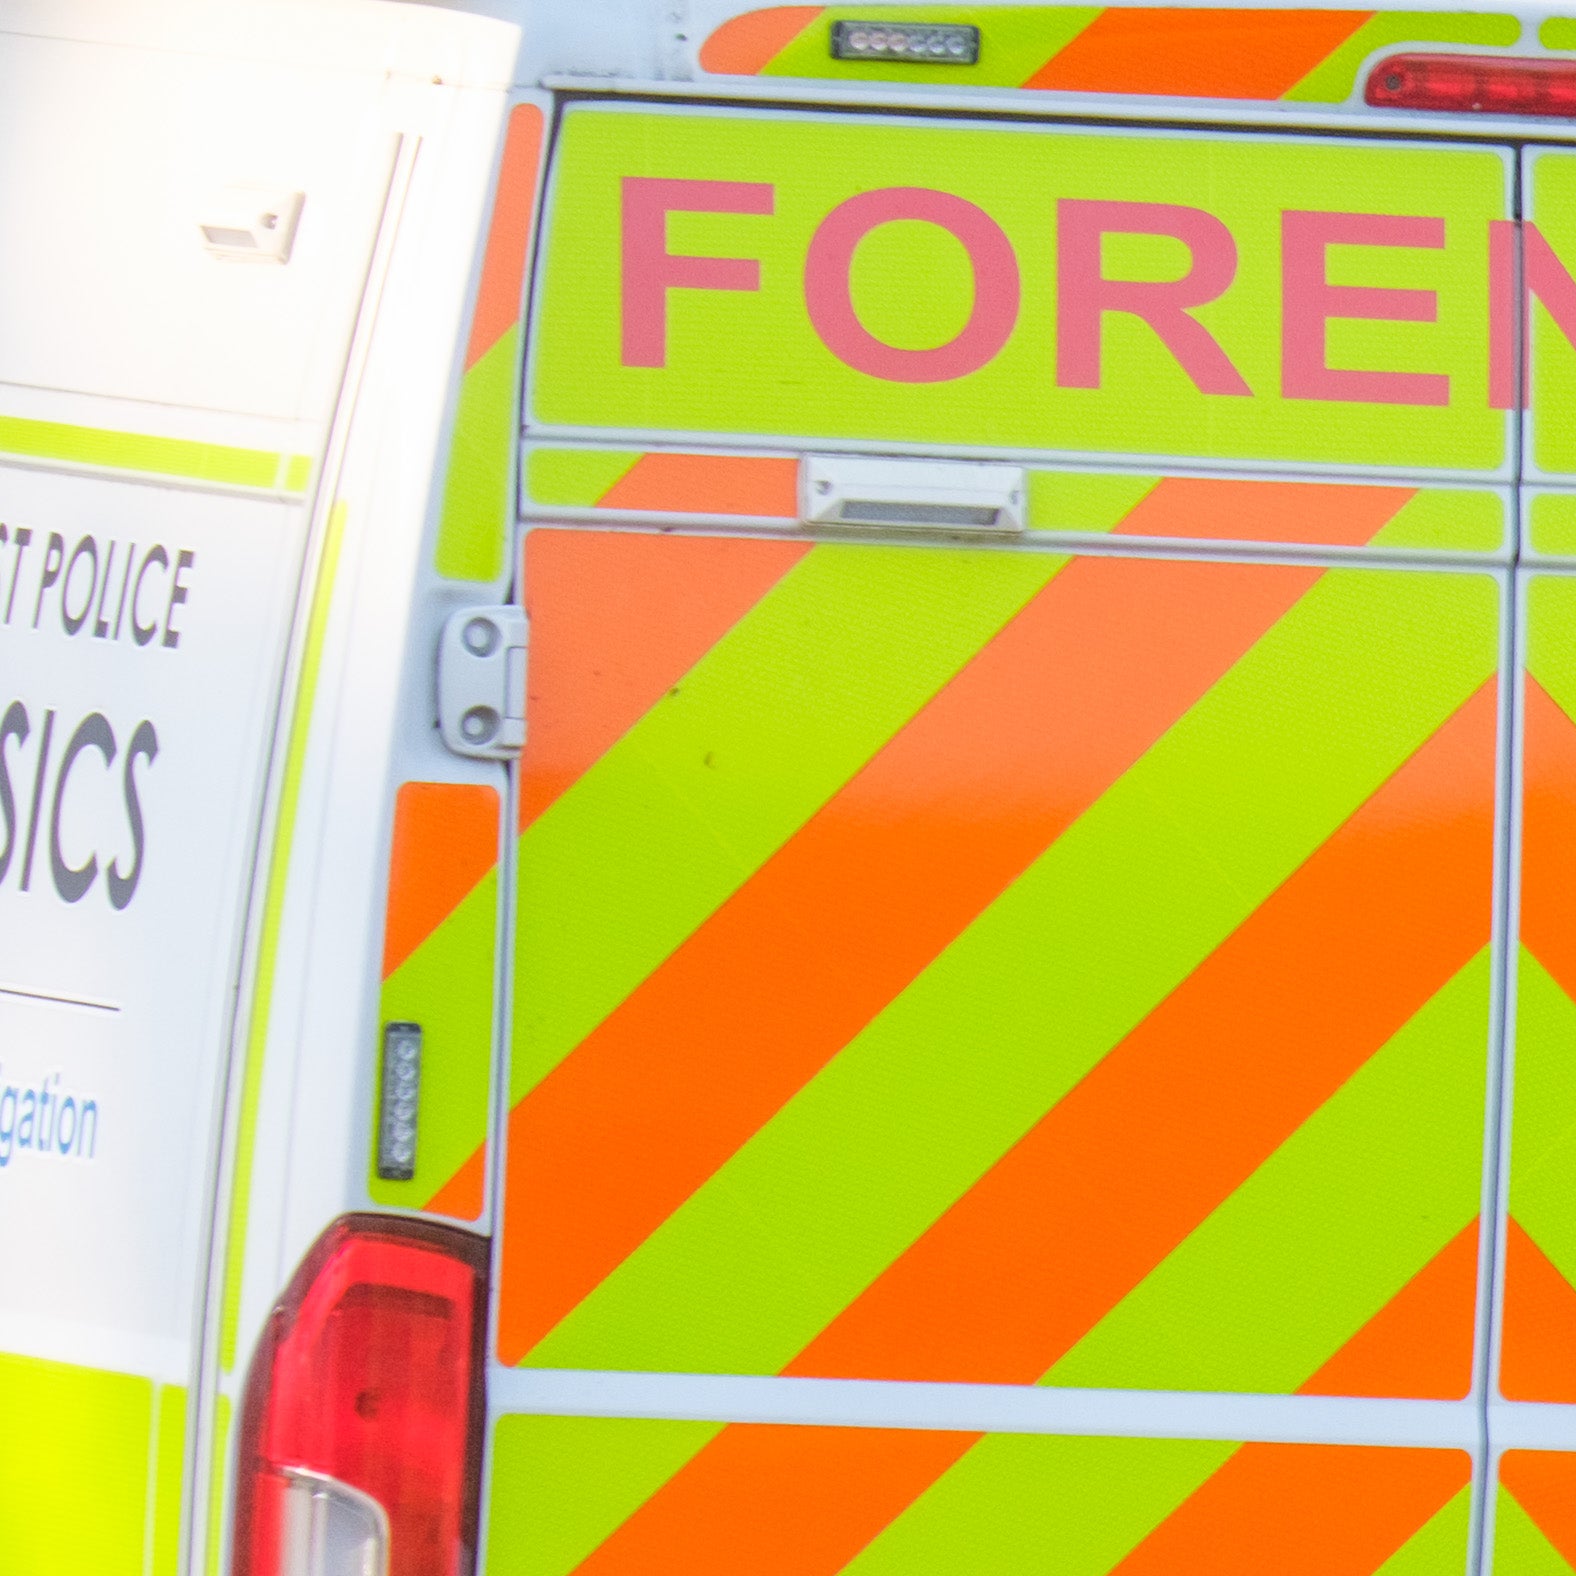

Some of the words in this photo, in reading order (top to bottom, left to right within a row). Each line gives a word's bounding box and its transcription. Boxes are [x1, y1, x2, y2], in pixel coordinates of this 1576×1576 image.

[0, 522, 33, 625] T
[31, 531, 195, 648] POLICE
[0, 700, 160, 911] SICS
[0, 1071, 98, 1168] gation
